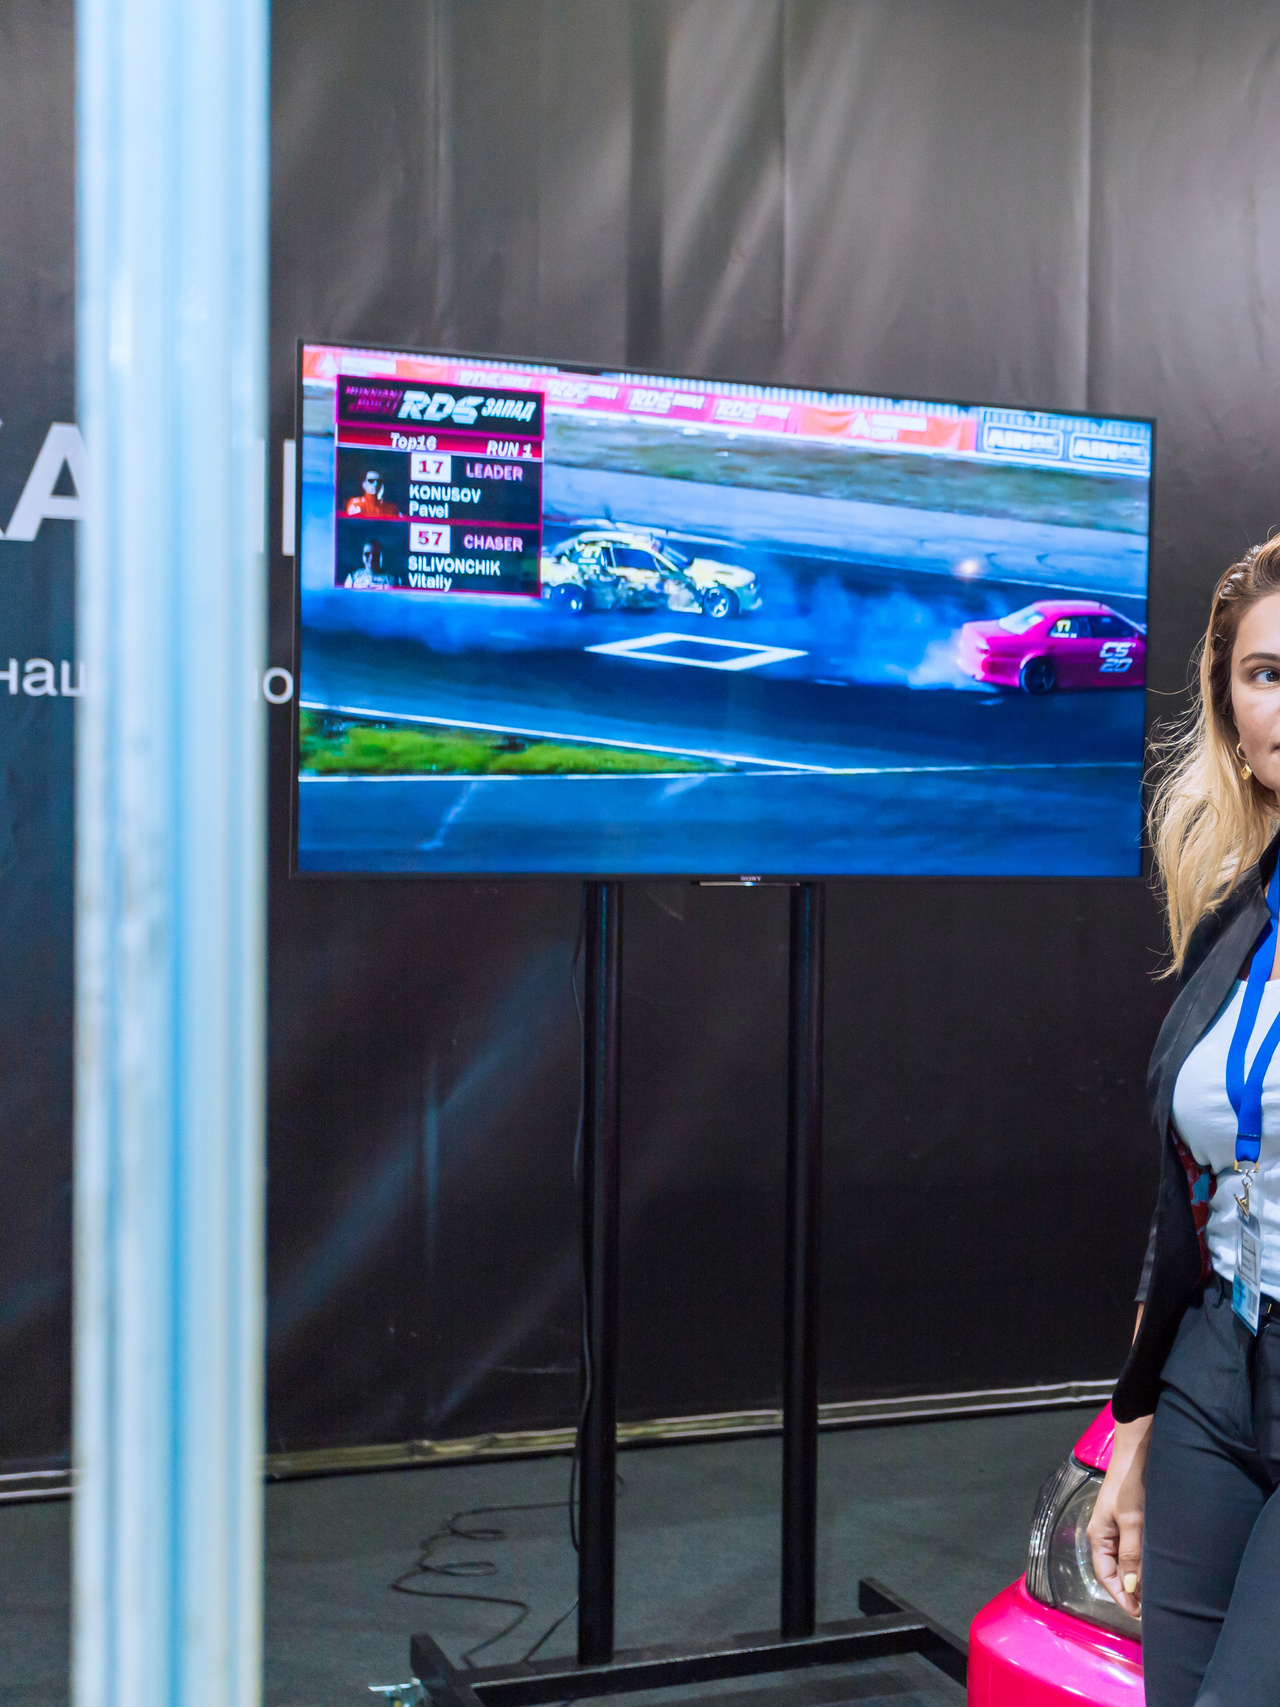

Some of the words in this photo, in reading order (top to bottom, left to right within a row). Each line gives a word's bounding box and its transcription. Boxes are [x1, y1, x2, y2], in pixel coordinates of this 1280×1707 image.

[398, 390, 484, 425] RDS
[480, 397, 537, 422] ЗАПАД
[390, 432, 438, 451] Top16
[486, 440, 520, 457] RUN
[522, 442, 533, 459] 1
[419, 461, 444, 474] 17
[465, 462, 524, 481] LEADER
[409, 500, 449, 519] Pavel
[418, 531, 443, 546] 57
[463, 534, 524, 552] CHASER
[408, 555, 501, 576] SILIVONCHIK
[408, 572, 452, 592] Vitaliy
